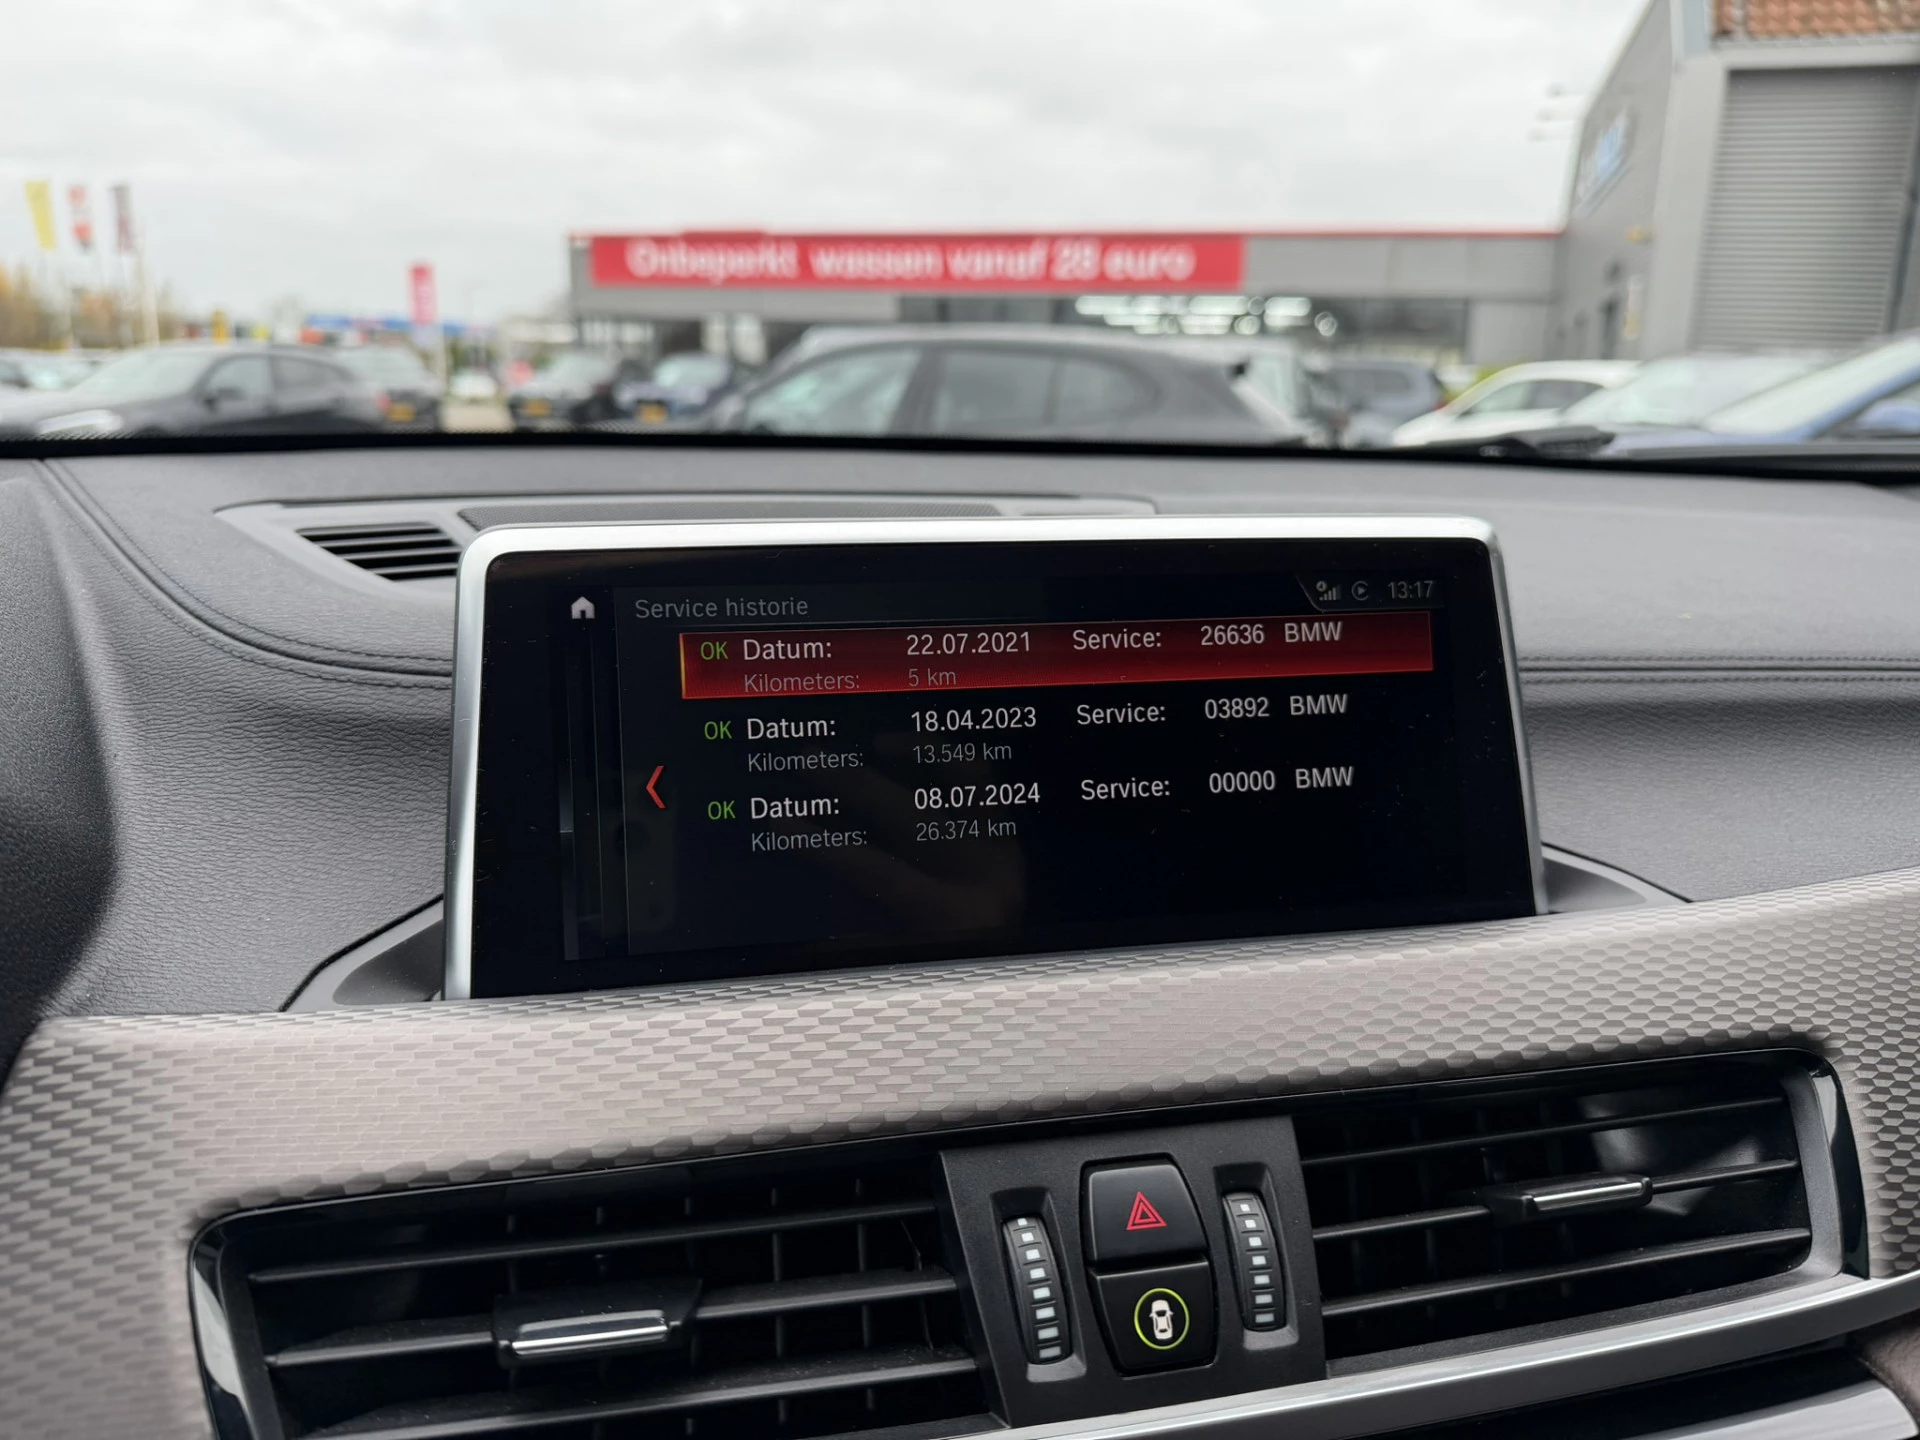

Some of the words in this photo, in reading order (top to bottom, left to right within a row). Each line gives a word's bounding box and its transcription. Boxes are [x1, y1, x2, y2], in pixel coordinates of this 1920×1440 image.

[810, 246, 942, 280] wassen
[946, 240, 1046, 280] vanaf
[1103, 246, 1196, 281] euro
[1388, 580, 1434, 600] 13:17
[635, 599, 718, 618] Service
[725, 597, 808, 617] historie
[701, 642, 728, 660] OK
[743, 637, 832, 660] Datum:
[906, 631, 1032, 656] 22.07.2021
[1072, 628, 1161, 651] Service:
[1201, 624, 1265, 646] 26636
[1284, 621, 1343, 643] BMW
[744, 672, 860, 692] Kilometers:
[908, 669, 920, 687] 5
[928, 668, 957, 686] km
[704, 721, 732, 739] OK
[747, 717, 836, 740] Datum:
[911, 706, 1037, 732] 18.04.2023
[1077, 703, 1166, 725] Service:
[1204, 697, 1270, 719] 03892
[1289, 693, 1348, 716] BMW
[748, 749, 864, 772] Kilometers:
[913, 745, 976, 764] 13.549
[983, 743, 1013, 761] km
[708, 801, 736, 820] OK
[750, 797, 840, 820] Datum:
[914, 782, 1041, 809] 08.07.2024
[1081, 778, 1170, 800] Service:
[1208, 770, 1276, 793] 00000
[1294, 766, 1354, 789] BMW
[751, 829, 867, 852] Kilometers:
[916, 821, 980, 842] 26.374
[987, 819, 1017, 838] km
